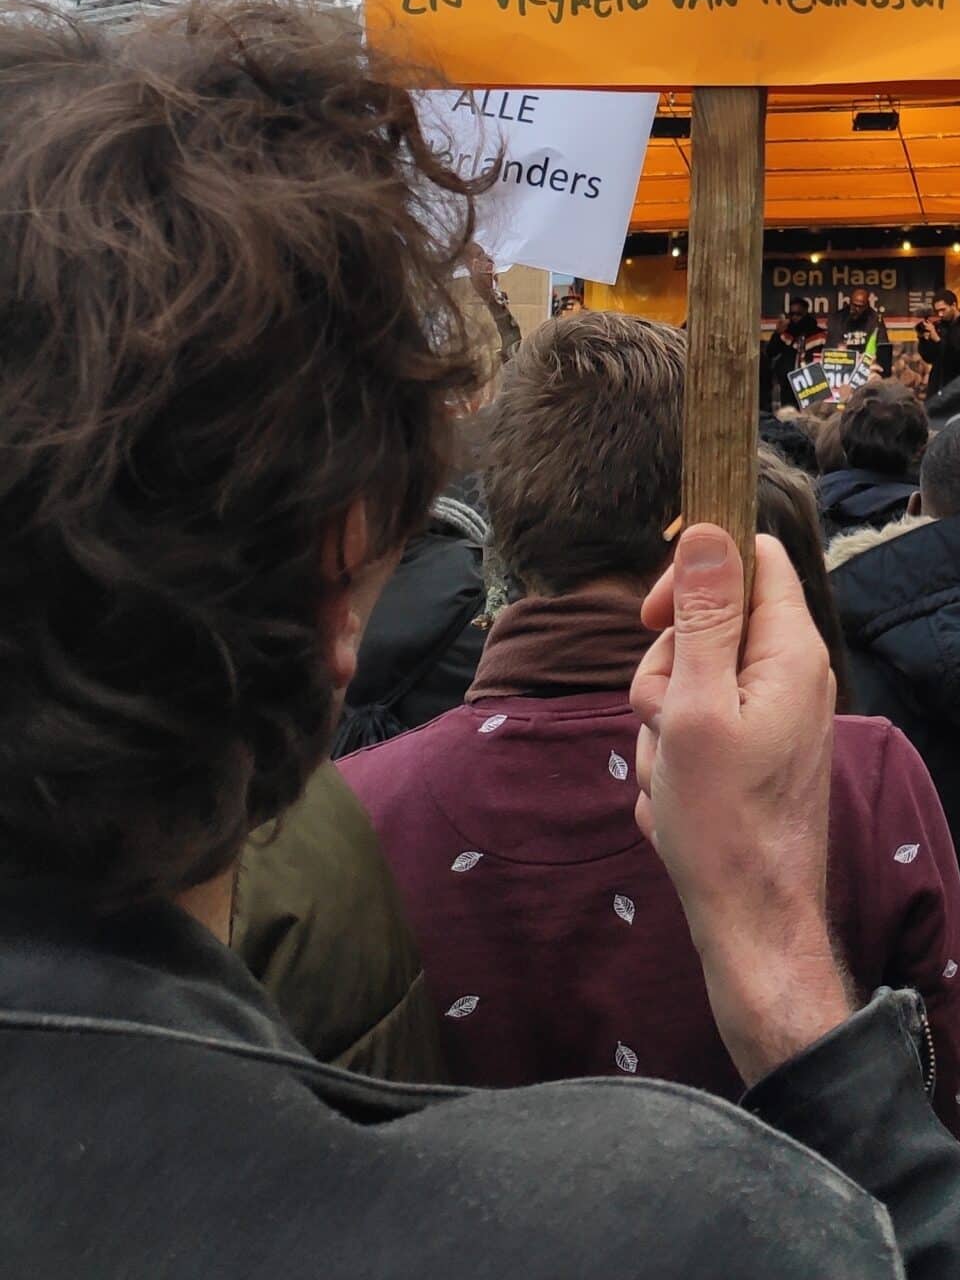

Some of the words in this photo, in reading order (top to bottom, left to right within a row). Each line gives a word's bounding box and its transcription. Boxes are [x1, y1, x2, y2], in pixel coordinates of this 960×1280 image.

[452, 90, 540, 124] ALLE
[773, 267, 823, 287] Den
[832, 266, 897, 289] Haag
[838, 291, 885, 313] ht.
